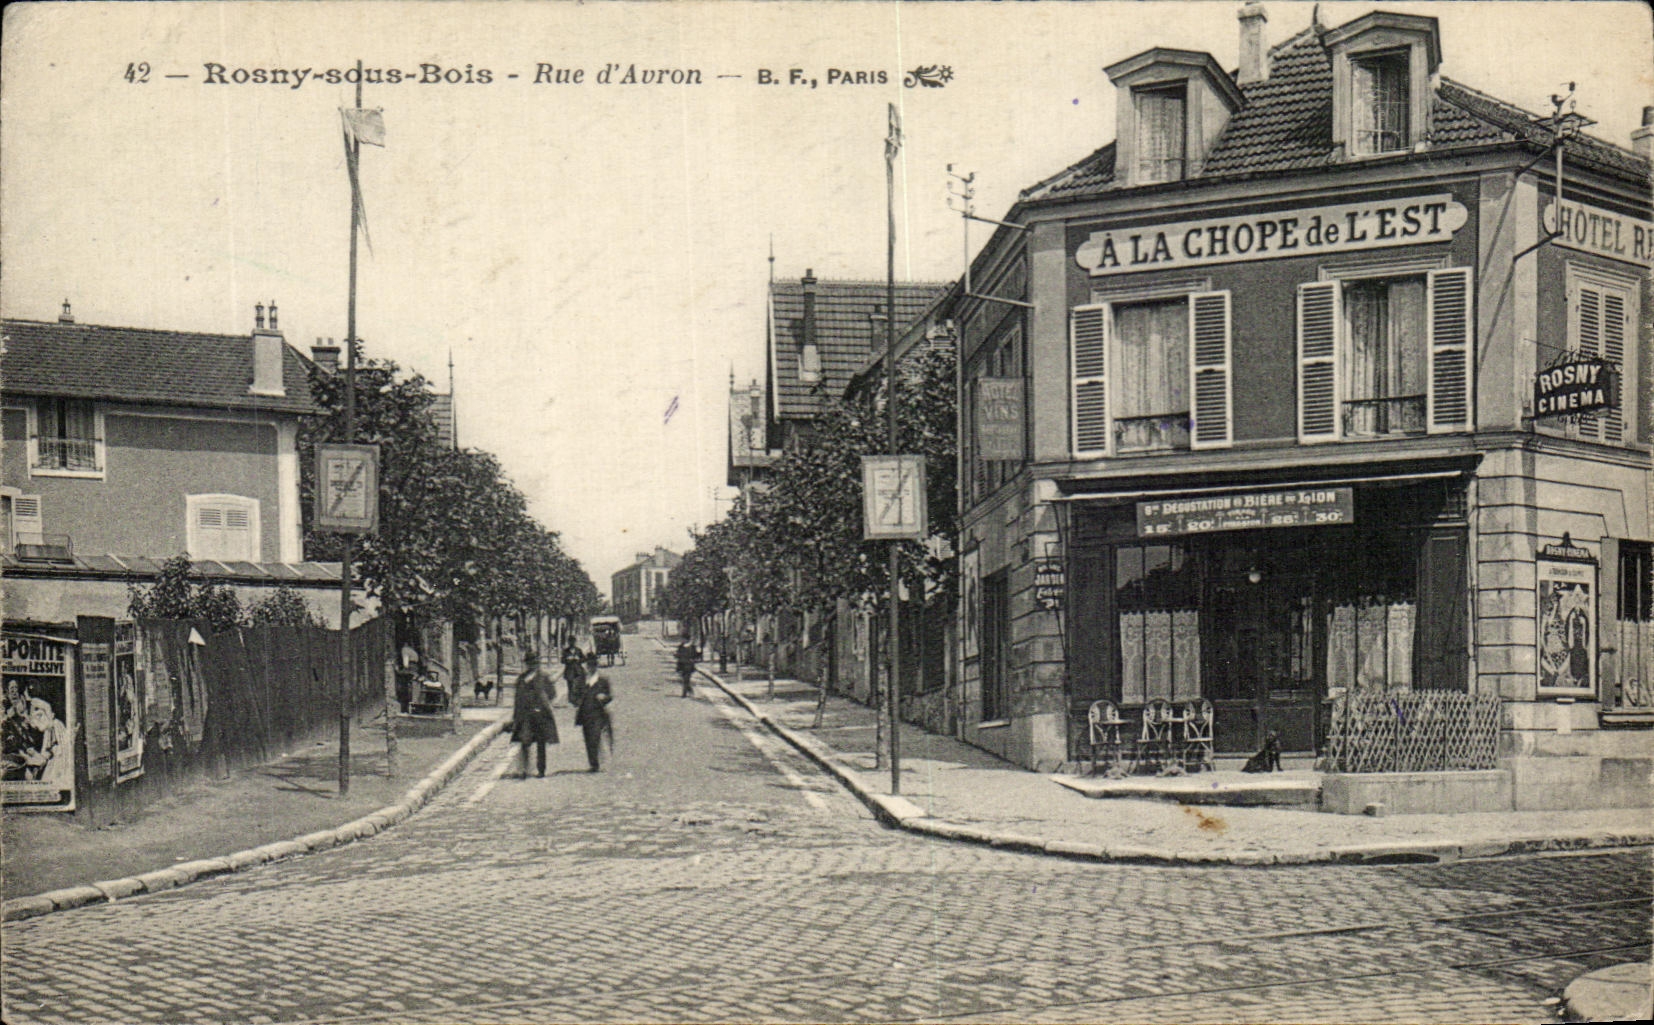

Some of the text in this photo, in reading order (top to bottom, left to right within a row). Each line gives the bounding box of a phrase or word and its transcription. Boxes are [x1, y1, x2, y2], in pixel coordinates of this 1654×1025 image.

[1130, 231, 1174, 264] LA
[1184, 218, 1299, 257] CHOPE
[1307, 215, 1340, 246] de
[1346, 202, 1446, 243] L'EST
[1540, 365, 1601, 393] ROSNY
[1539, 390, 1604, 413] CINEMA
